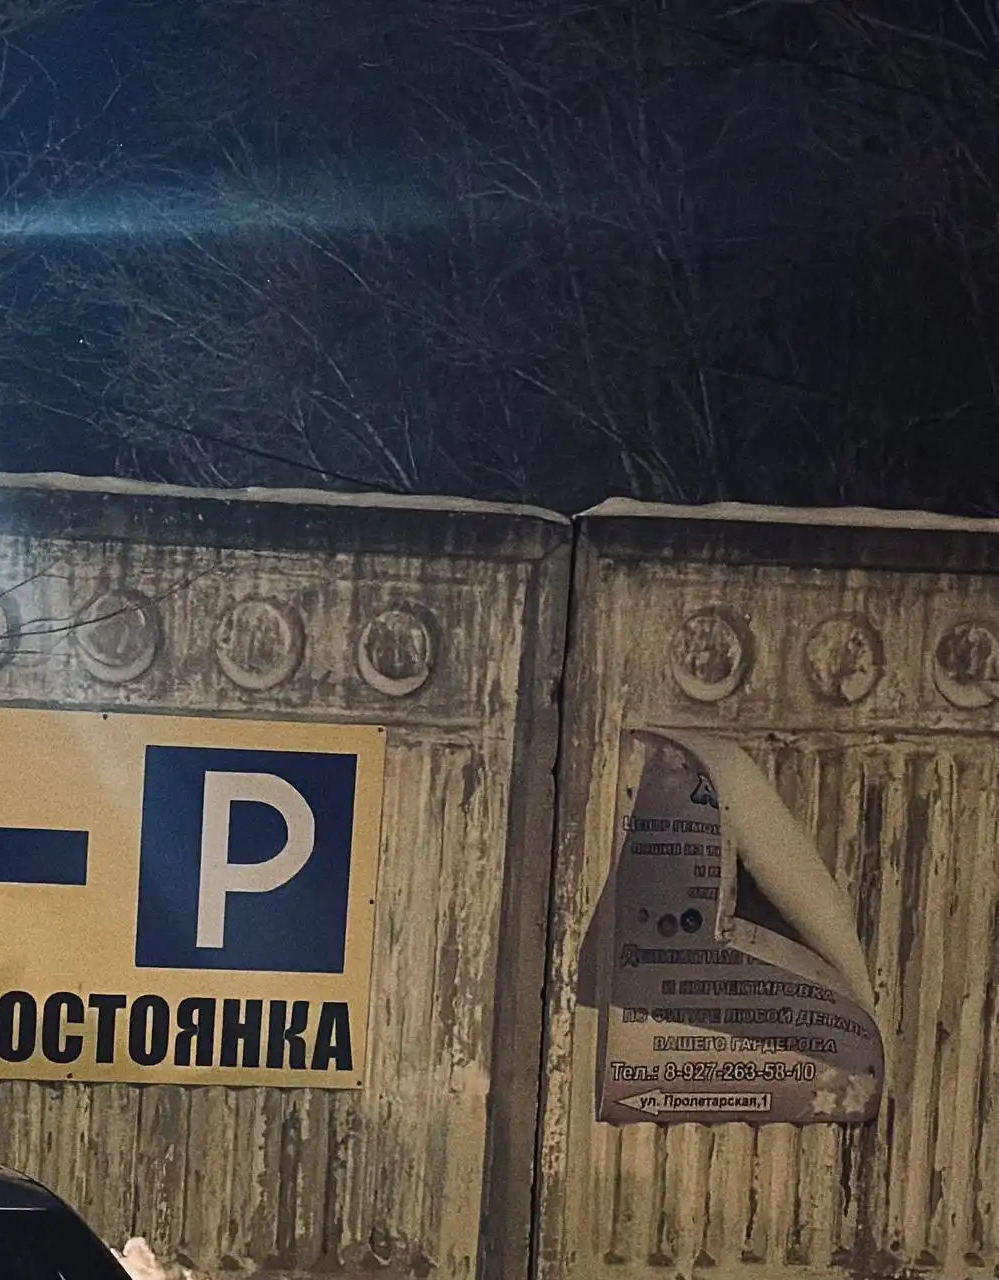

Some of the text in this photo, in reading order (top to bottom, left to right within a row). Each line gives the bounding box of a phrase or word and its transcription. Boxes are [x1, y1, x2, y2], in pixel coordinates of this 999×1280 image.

[196, 770, 316, 949] P
[653, 1035, 838, 1054] ВАШЕГО ГАРДЕРОБА
[611, 1061, 816, 1082] Тел.: 8-927-263-58-10
